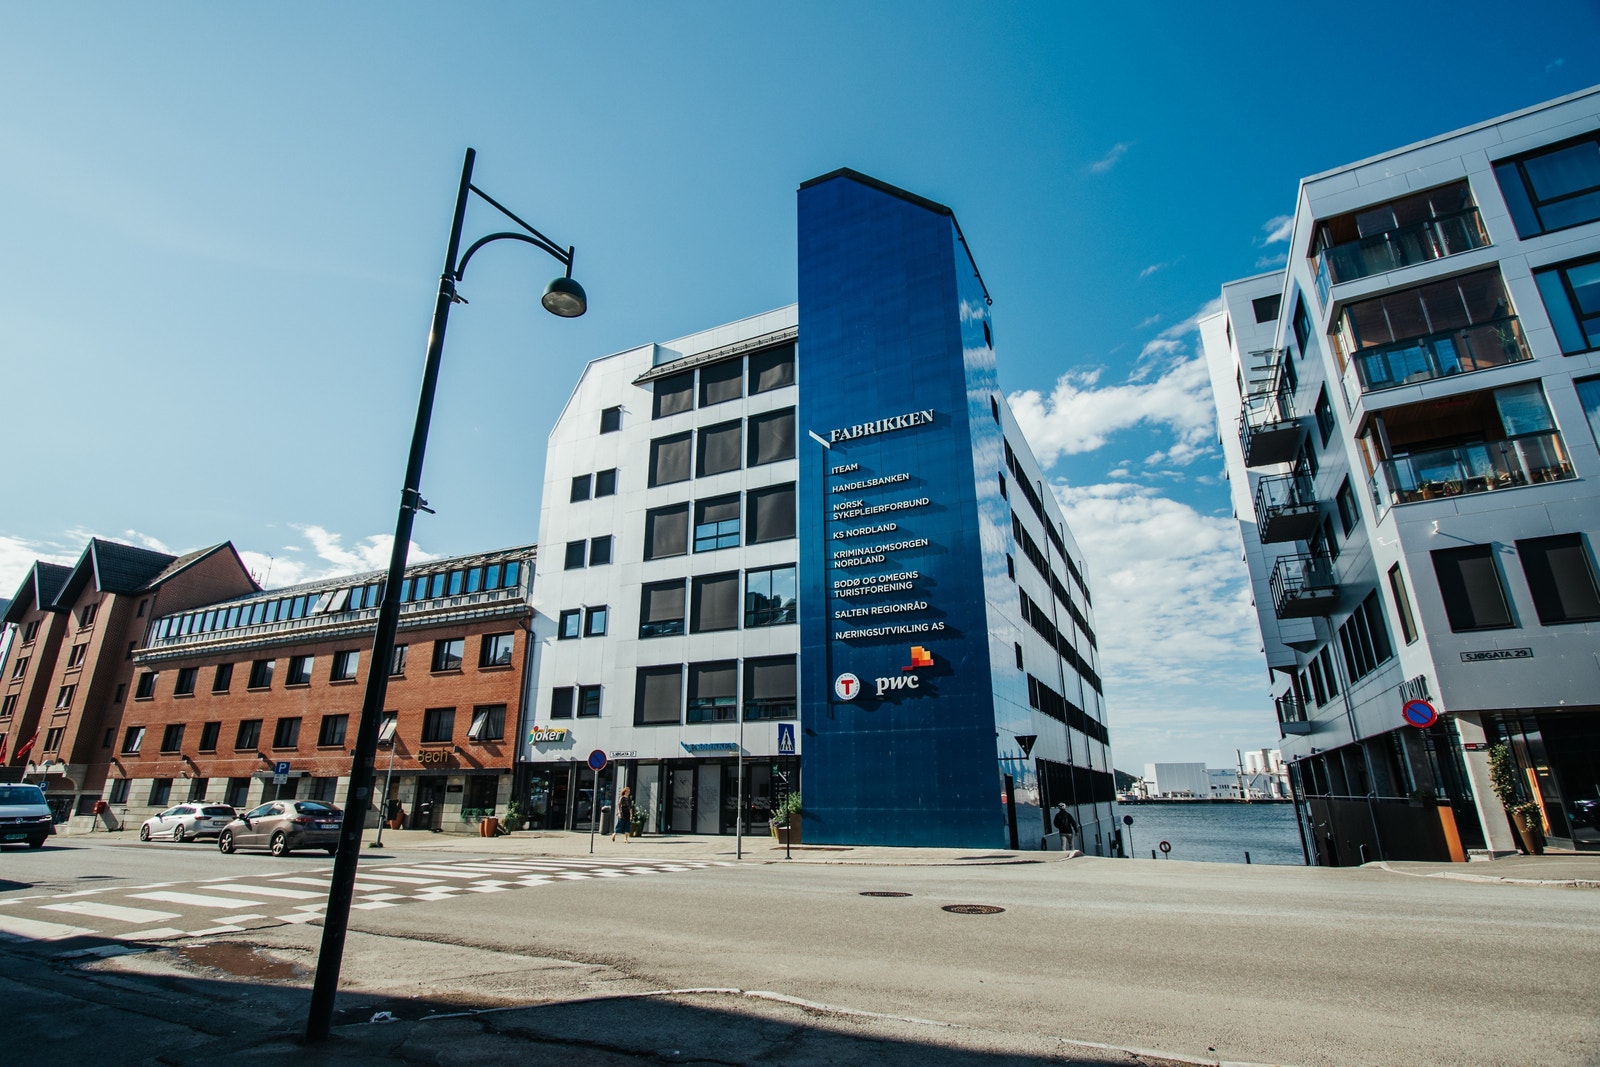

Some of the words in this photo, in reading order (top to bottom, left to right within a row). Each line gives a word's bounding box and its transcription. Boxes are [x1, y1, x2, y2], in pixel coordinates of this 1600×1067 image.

[830, 408, 935, 443] FABRIKKEN
[831, 463, 858, 475] ITEAM
[832, 472, 910, 493] HANDELSBANKEN
[833, 499, 864, 511] NORSK
[833, 497, 929, 520] SYKEPLEIERFORBUND
[833, 531, 844, 540] KS
[846, 523, 897, 537] NORDLAND
[833, 538, 928, 559] KRIMINALOMSORGEN
[834, 555, 885, 568] NORDLAND
[834, 578, 861, 588] BODØ
[862, 576, 876, 585] OG
[878, 571, 919, 582] OMEGNS
[834, 581, 913, 598] TURISTFORENING
[835, 607, 869, 619] SALTEN
[871, 600, 928, 615] REGIONRÅD
[835, 622, 929, 640] NÆRINGSUTVIKLING
[931, 621, 945, 631] AS
[1465, 650, 1511, 660] SJØGATA
[1514, 649, 1527, 657] 29
[875, 675, 920, 696] pwc
[528, 725, 562, 745] joker
[417, 747, 448, 763] Bech
[278, 763, 287, 773] P
